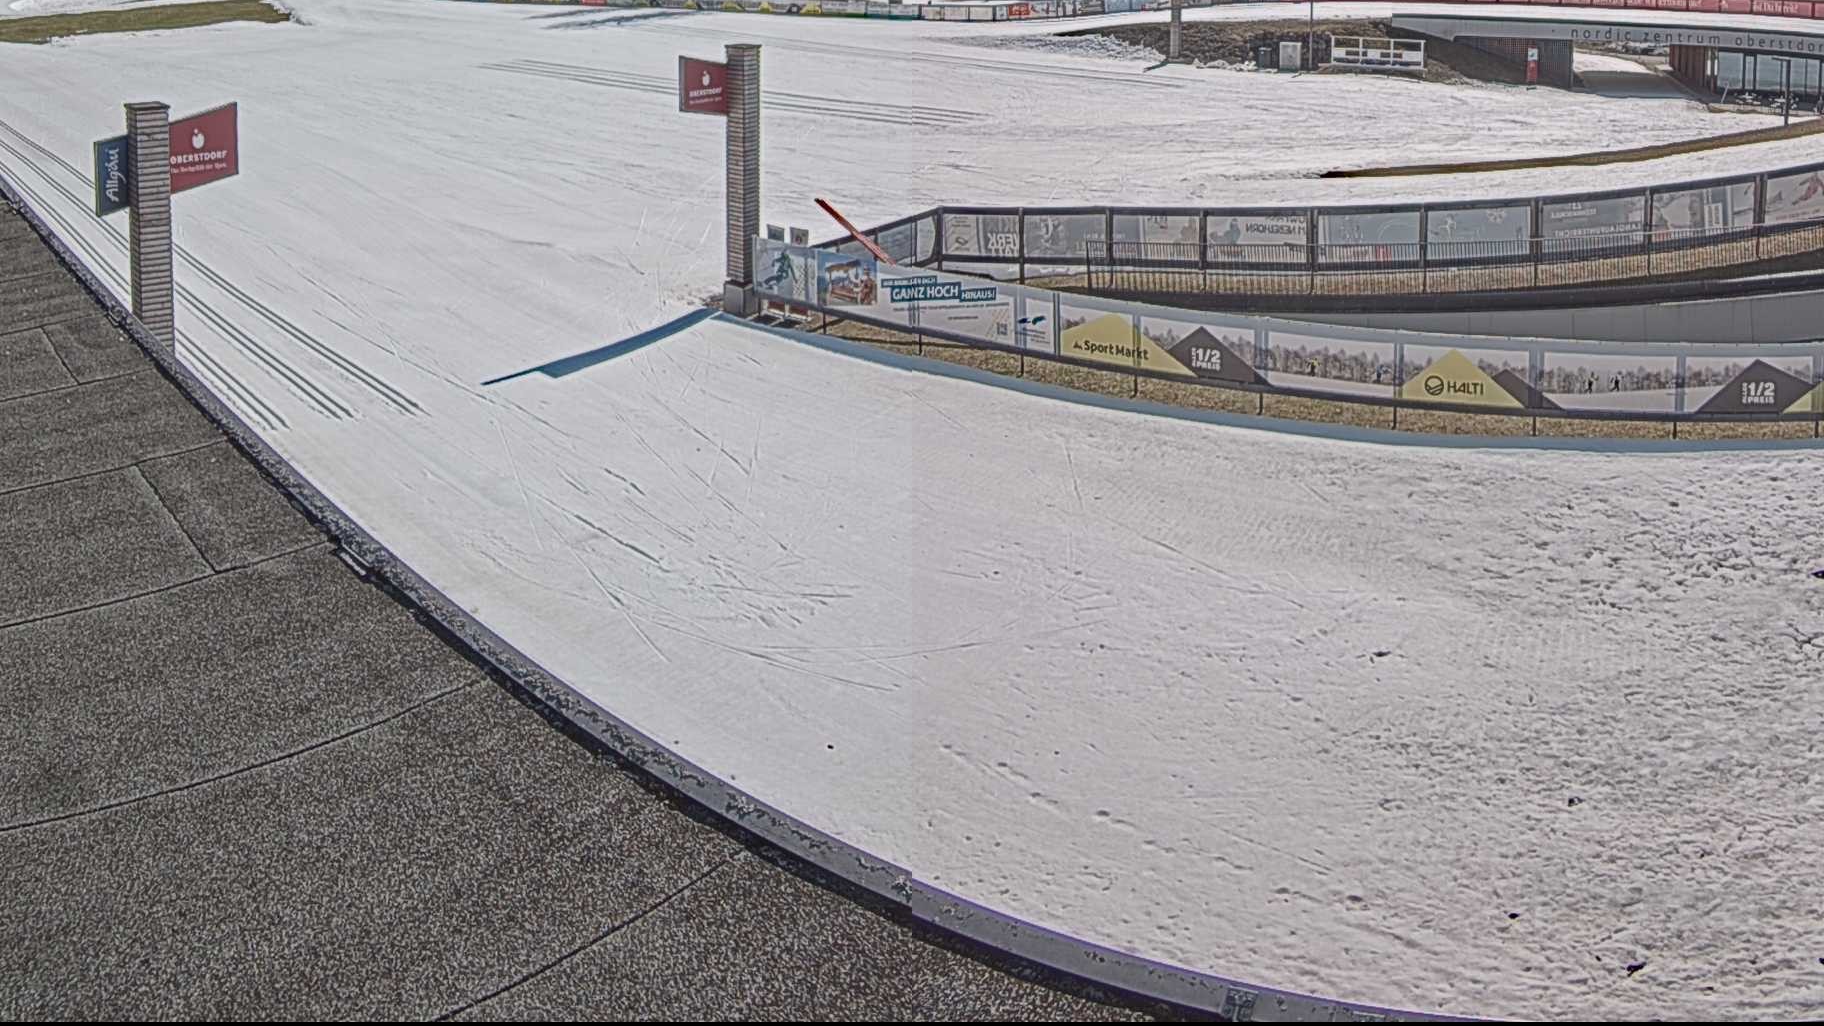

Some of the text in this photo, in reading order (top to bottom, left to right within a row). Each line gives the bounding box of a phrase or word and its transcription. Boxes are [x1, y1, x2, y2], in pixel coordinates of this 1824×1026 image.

[1571, 27, 1631, 41] nordic
[1643, 31, 1721, 44] zentrum
[170, 150, 228, 164] OBERSTDORF
[105, 147, 127, 202] Allgäu
[926, 285, 959, 299] HOCH
[1197, 348, 1221, 363] 1/2
[1447, 380, 1484, 395] HALTI
[1748, 381, 1775, 396] 1/2
